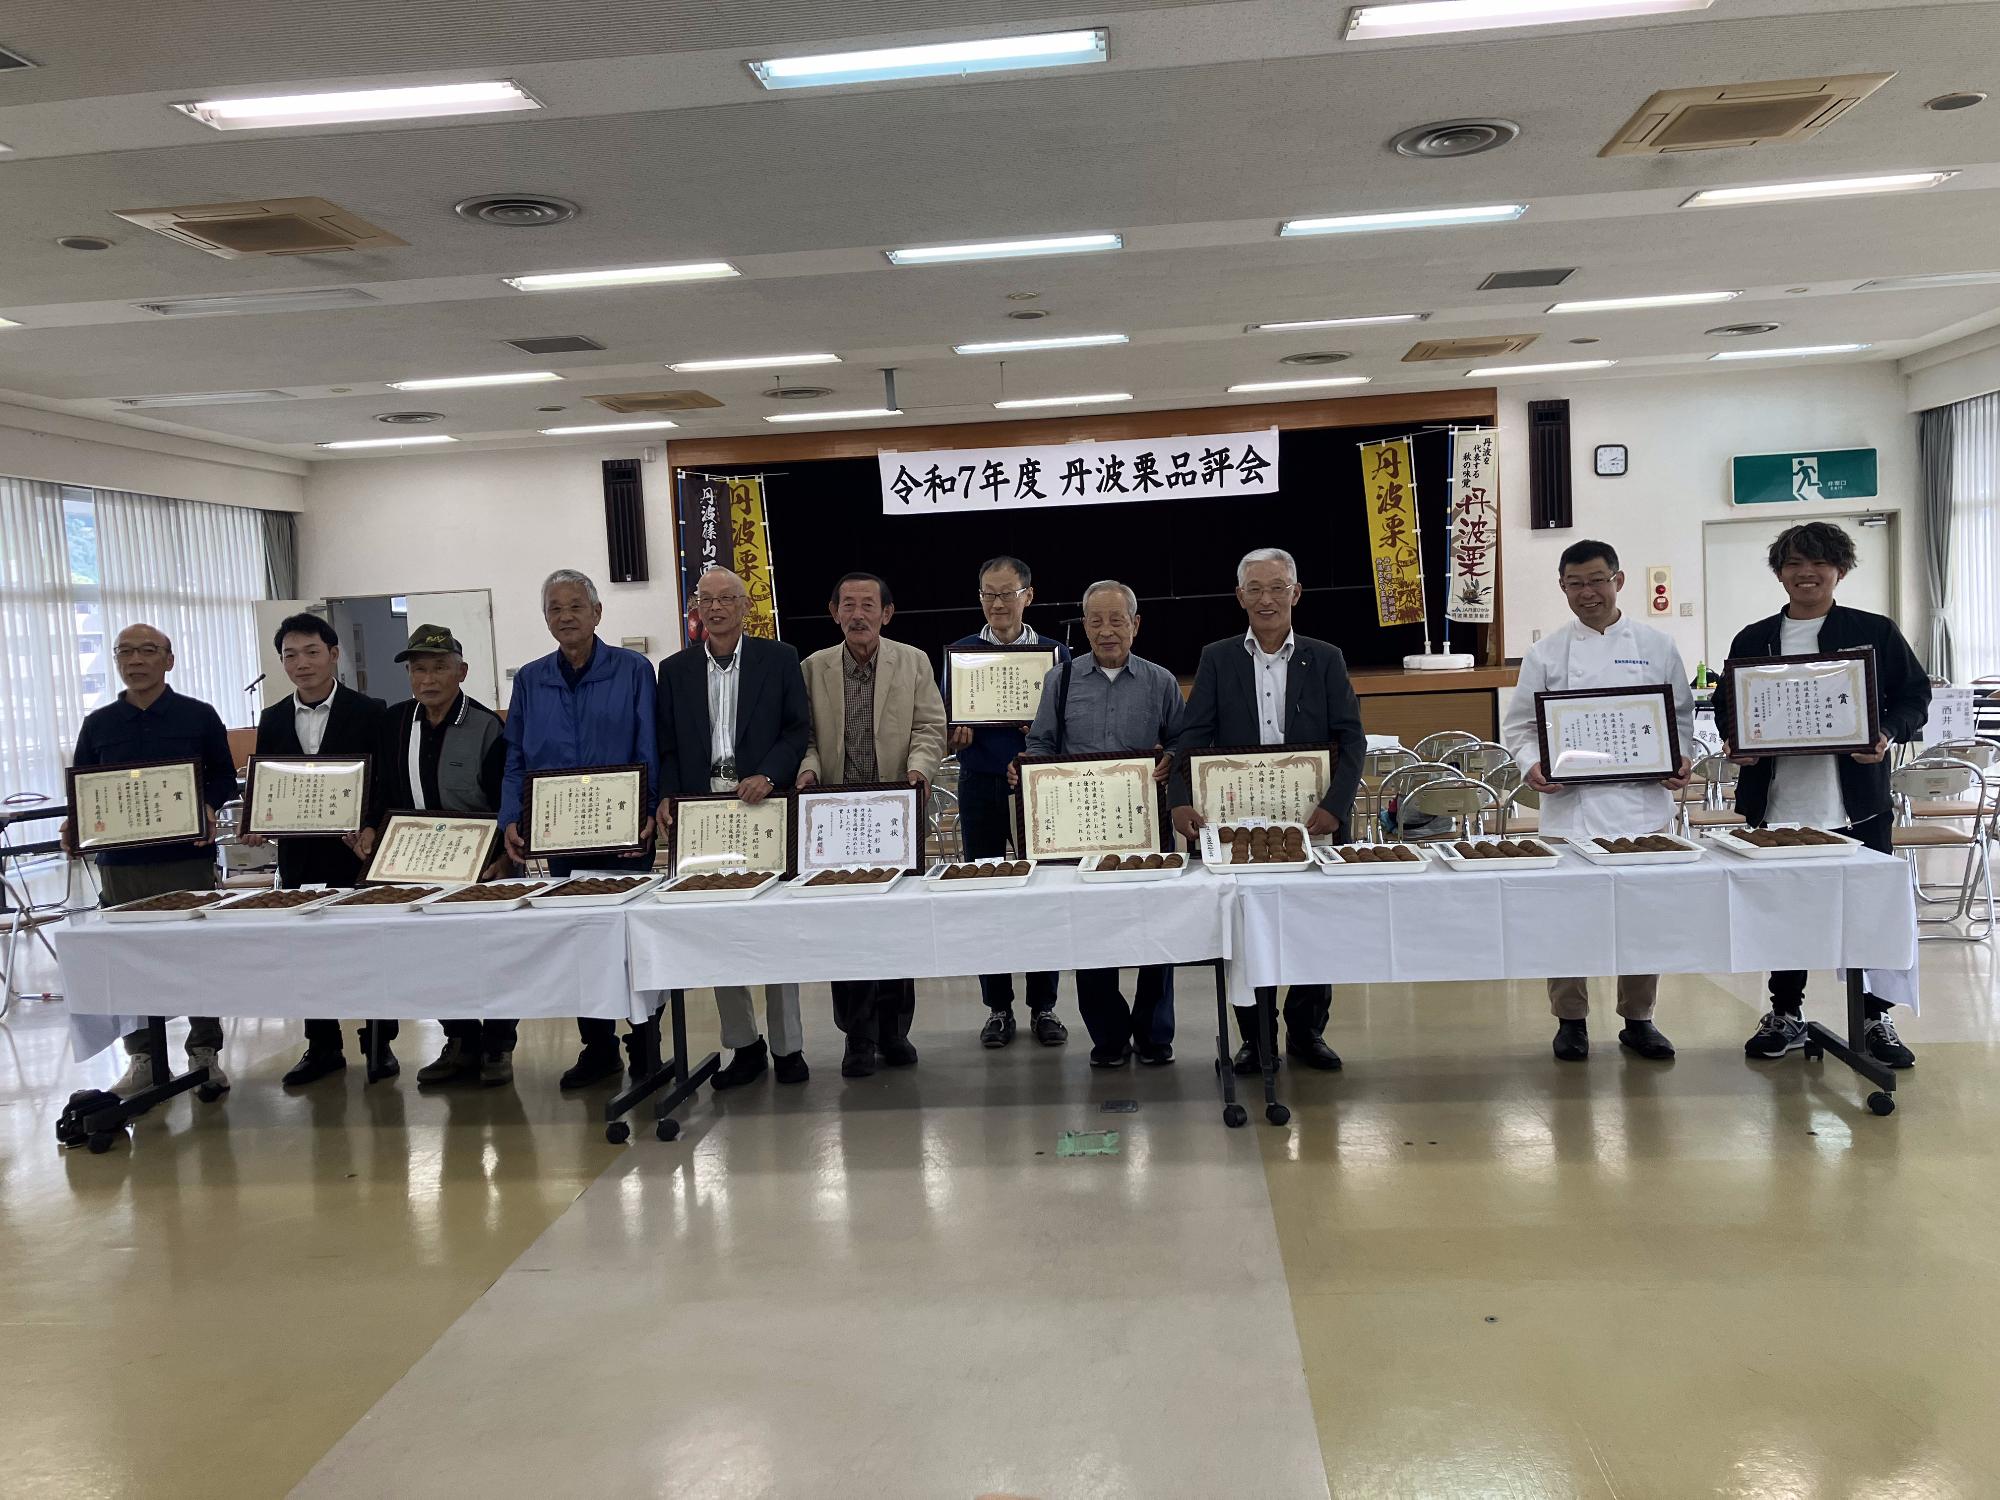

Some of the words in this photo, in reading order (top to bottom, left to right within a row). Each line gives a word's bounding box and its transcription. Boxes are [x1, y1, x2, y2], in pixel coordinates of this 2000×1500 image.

[1473, 444, 1482, 478] 代表する
[1483, 437, 1493, 465] 丹波を
[890, 457, 1048, 505] 令和7年度
[1059, 444, 1272, 496] 丹波栗品評会
[1461, 452, 1472, 489] 秋の味覚
[1371, 446, 1410, 549] 丹波栗
[729, 483, 763, 581] 丹波栗
[1456, 487, 1491, 579] 丹波栗
[1837, 693, 1849, 705] 賞
[1641, 724, 1652, 735] 賞
